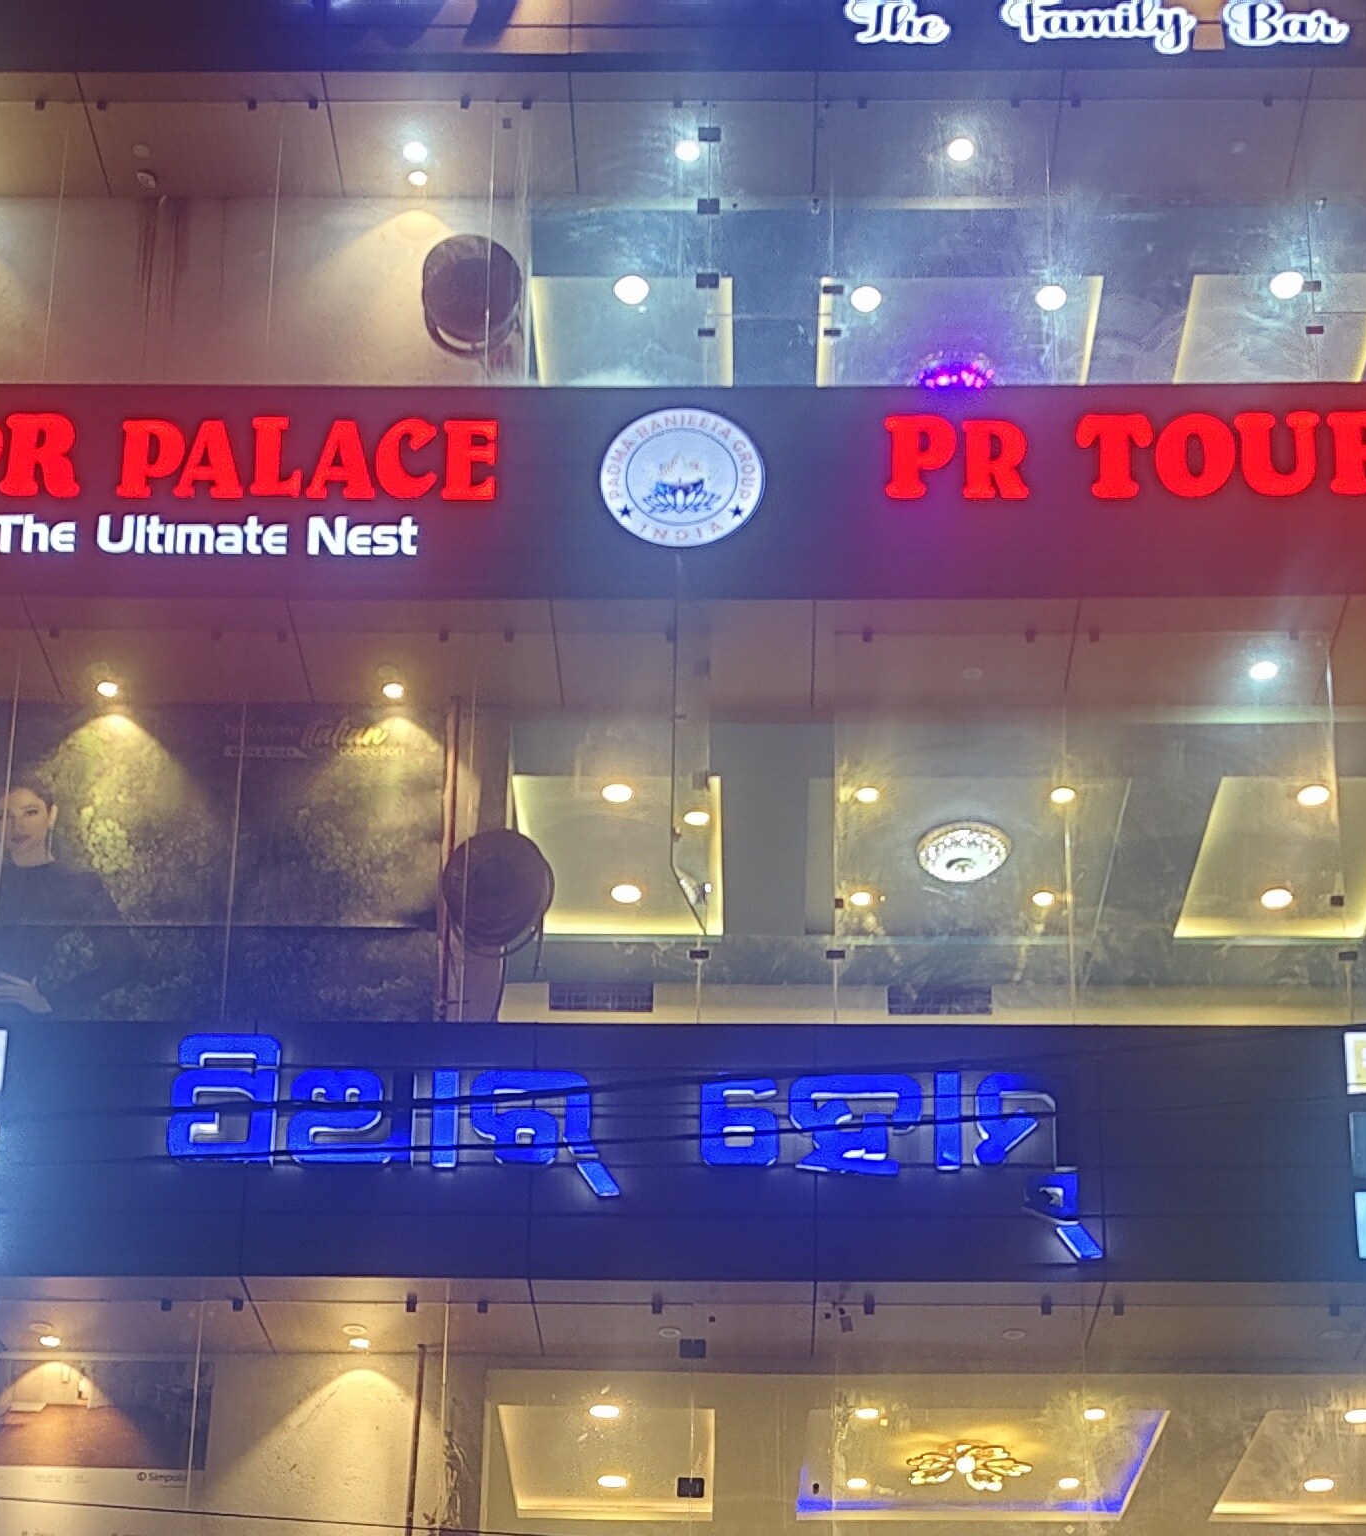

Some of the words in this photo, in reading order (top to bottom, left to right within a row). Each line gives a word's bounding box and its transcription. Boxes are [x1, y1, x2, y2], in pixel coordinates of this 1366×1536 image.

[844, 0, 951, 45] The
[1224, 0, 1350, 46] Bar
[116, 416, 499, 501] PALACE
[733, 439, 756, 501] GROUP
[884, 414, 1029, 500] PR
[97, 514, 288, 556] Ultimate
[307, 516, 420, 557] Nest
[640, 521, 724, 541] INDIA
